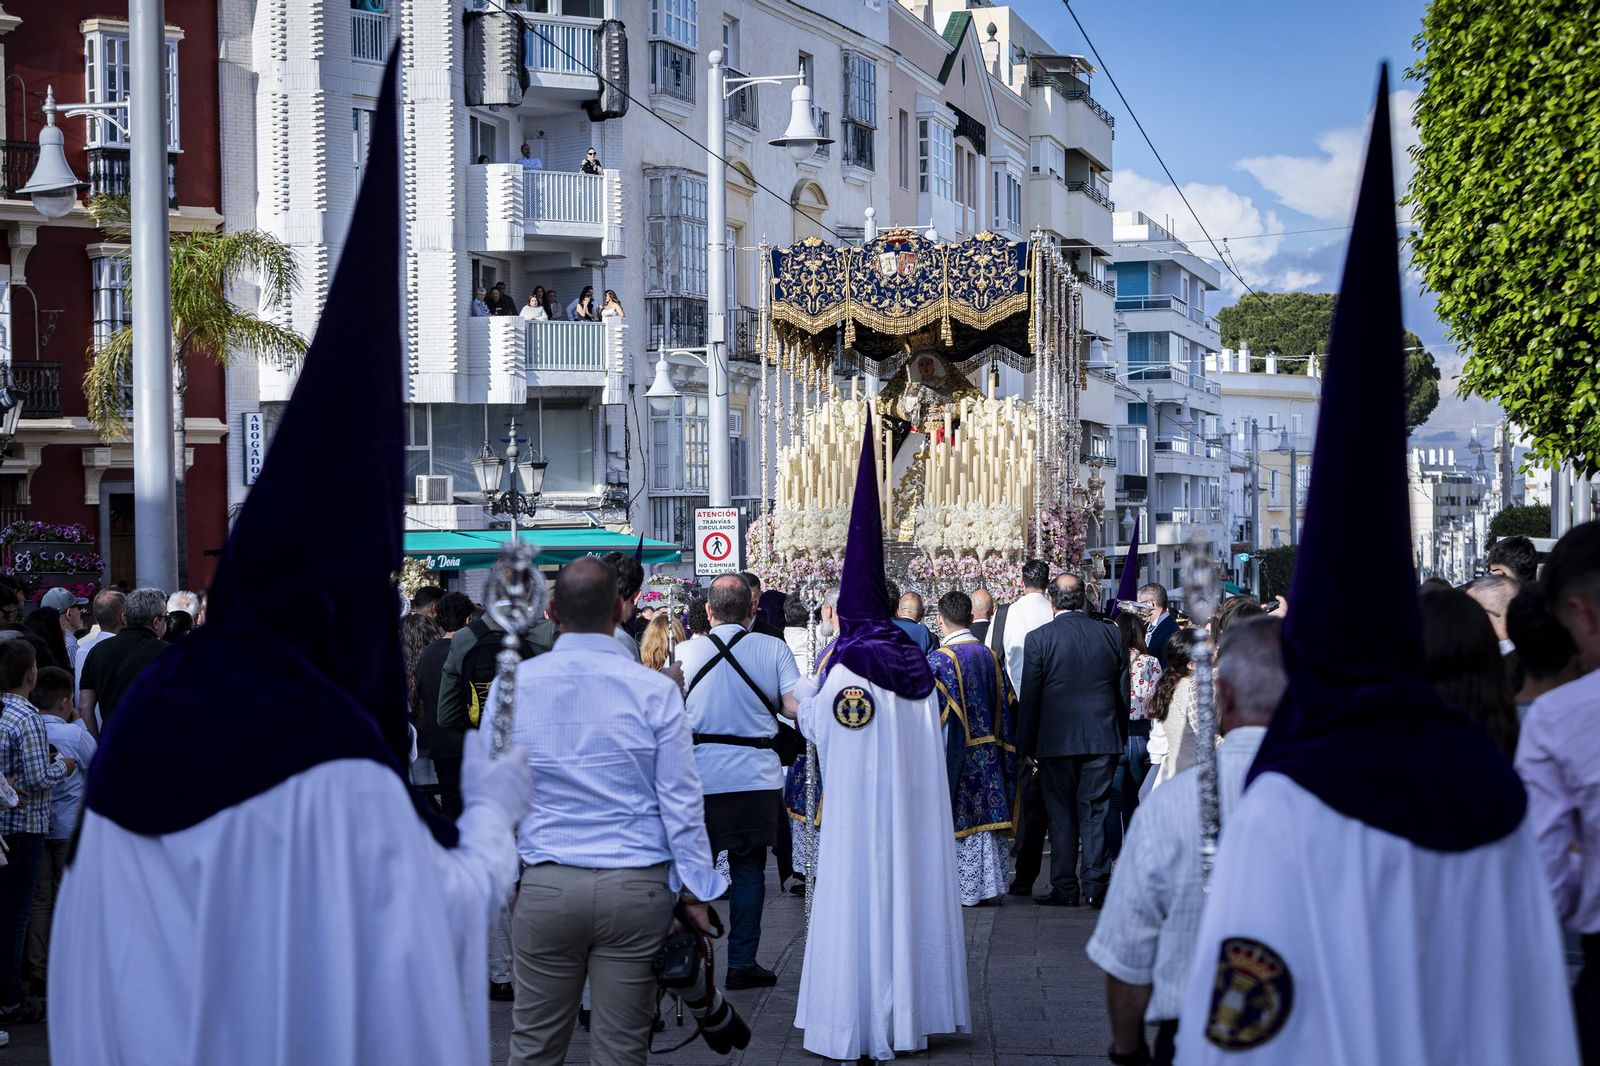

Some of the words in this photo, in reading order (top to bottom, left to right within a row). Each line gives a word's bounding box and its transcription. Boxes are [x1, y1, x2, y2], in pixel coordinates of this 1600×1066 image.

[250, 415, 260, 483] ABOGADOS
[426, 555, 435, 569] La
[437, 555, 460, 568] Doña
